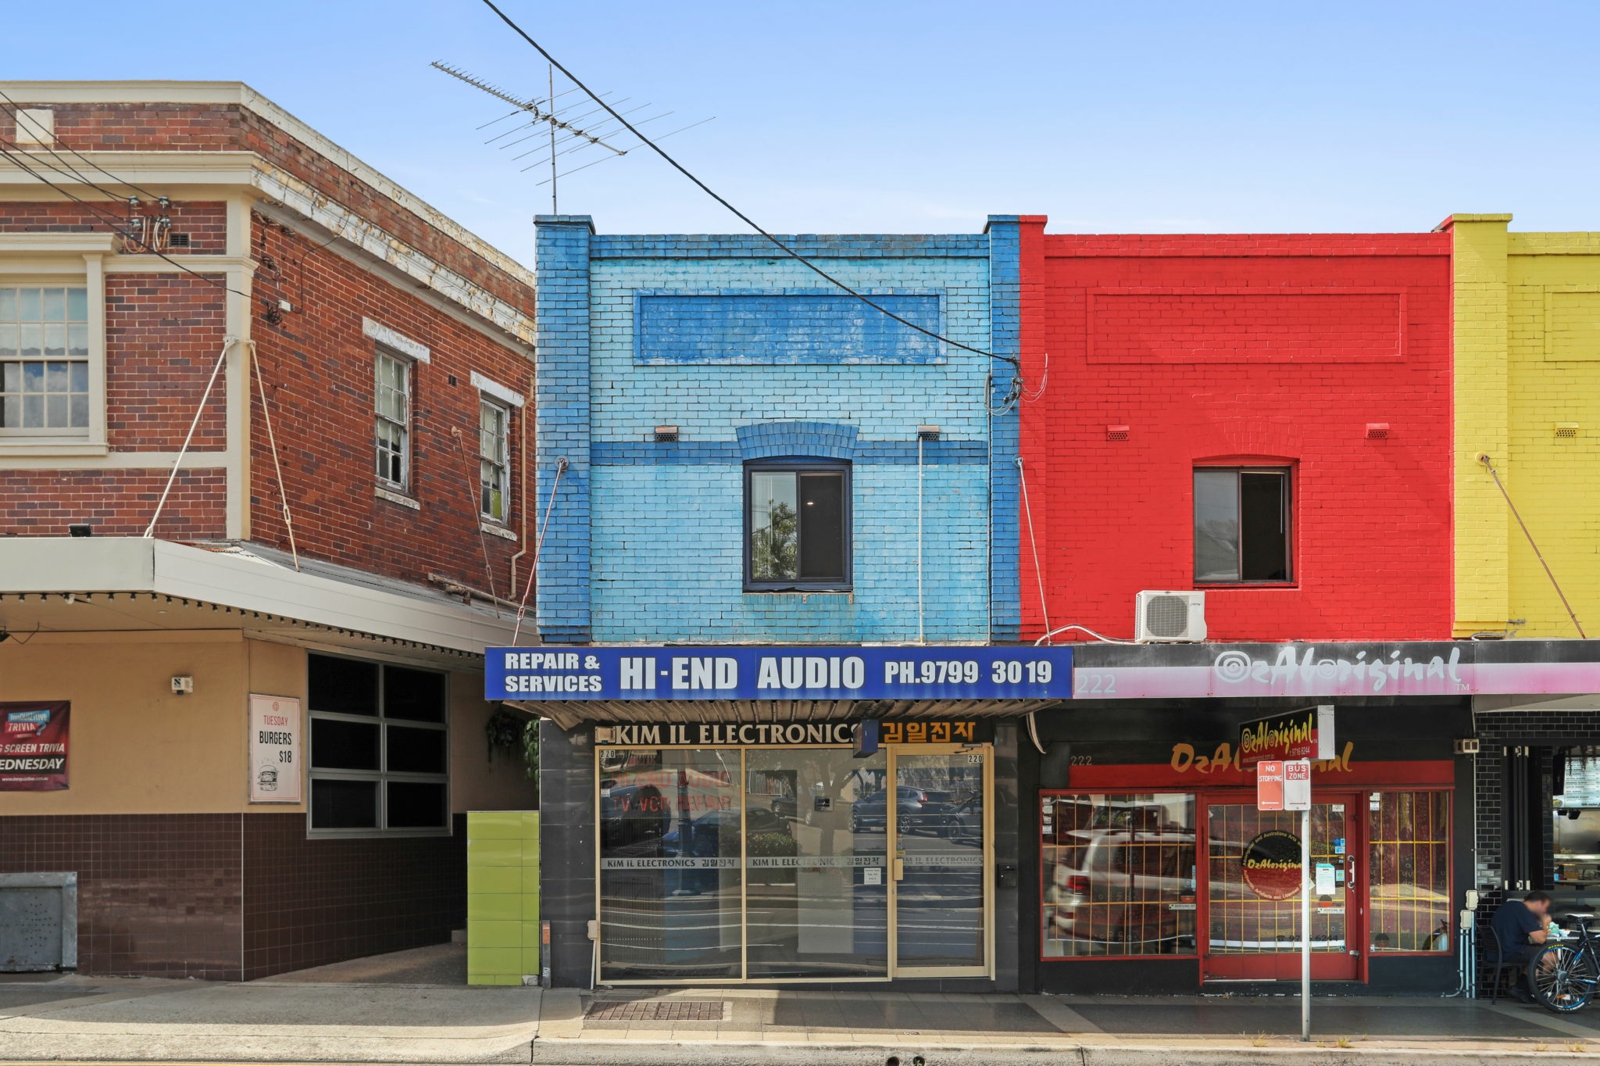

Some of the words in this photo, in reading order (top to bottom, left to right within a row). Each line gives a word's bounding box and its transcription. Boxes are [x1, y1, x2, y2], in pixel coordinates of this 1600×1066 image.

[505, 653, 579, 670] REPAIR
[584, 655, 600, 670] &
[757, 656, 865, 690] AUDIO
[884, 660, 979, 684] PH.9799
[991, 660, 1052, 684] 3019
[505, 676, 602, 692] SERVICES
[1077, 674, 1116, 694] 222
[8, 722, 36, 732] TRIVIA
[263, 715, 289, 727] TUESDAY
[259, 731, 292, 745] BURGERS
[615, 725, 661, 745] KIM
[669, 725, 691, 744] IL
[882, 721, 976, 743] 김일전자
[4, 743, 37, 753] SCREEN
[39, 743, 65, 753] TRIVIA
[600, 750, 615, 758] 220
[279, 750, 292, 763] $18
[968, 755, 983, 763] 220
[1070, 756, 1093, 766] 222
[0, 758, 64, 770] EDNESDAY
[607, 859, 624, 867] KIM
[637, 859, 696, 867] ELECTRONICS
[926, 857, 984, 865] ELECTRONICS
